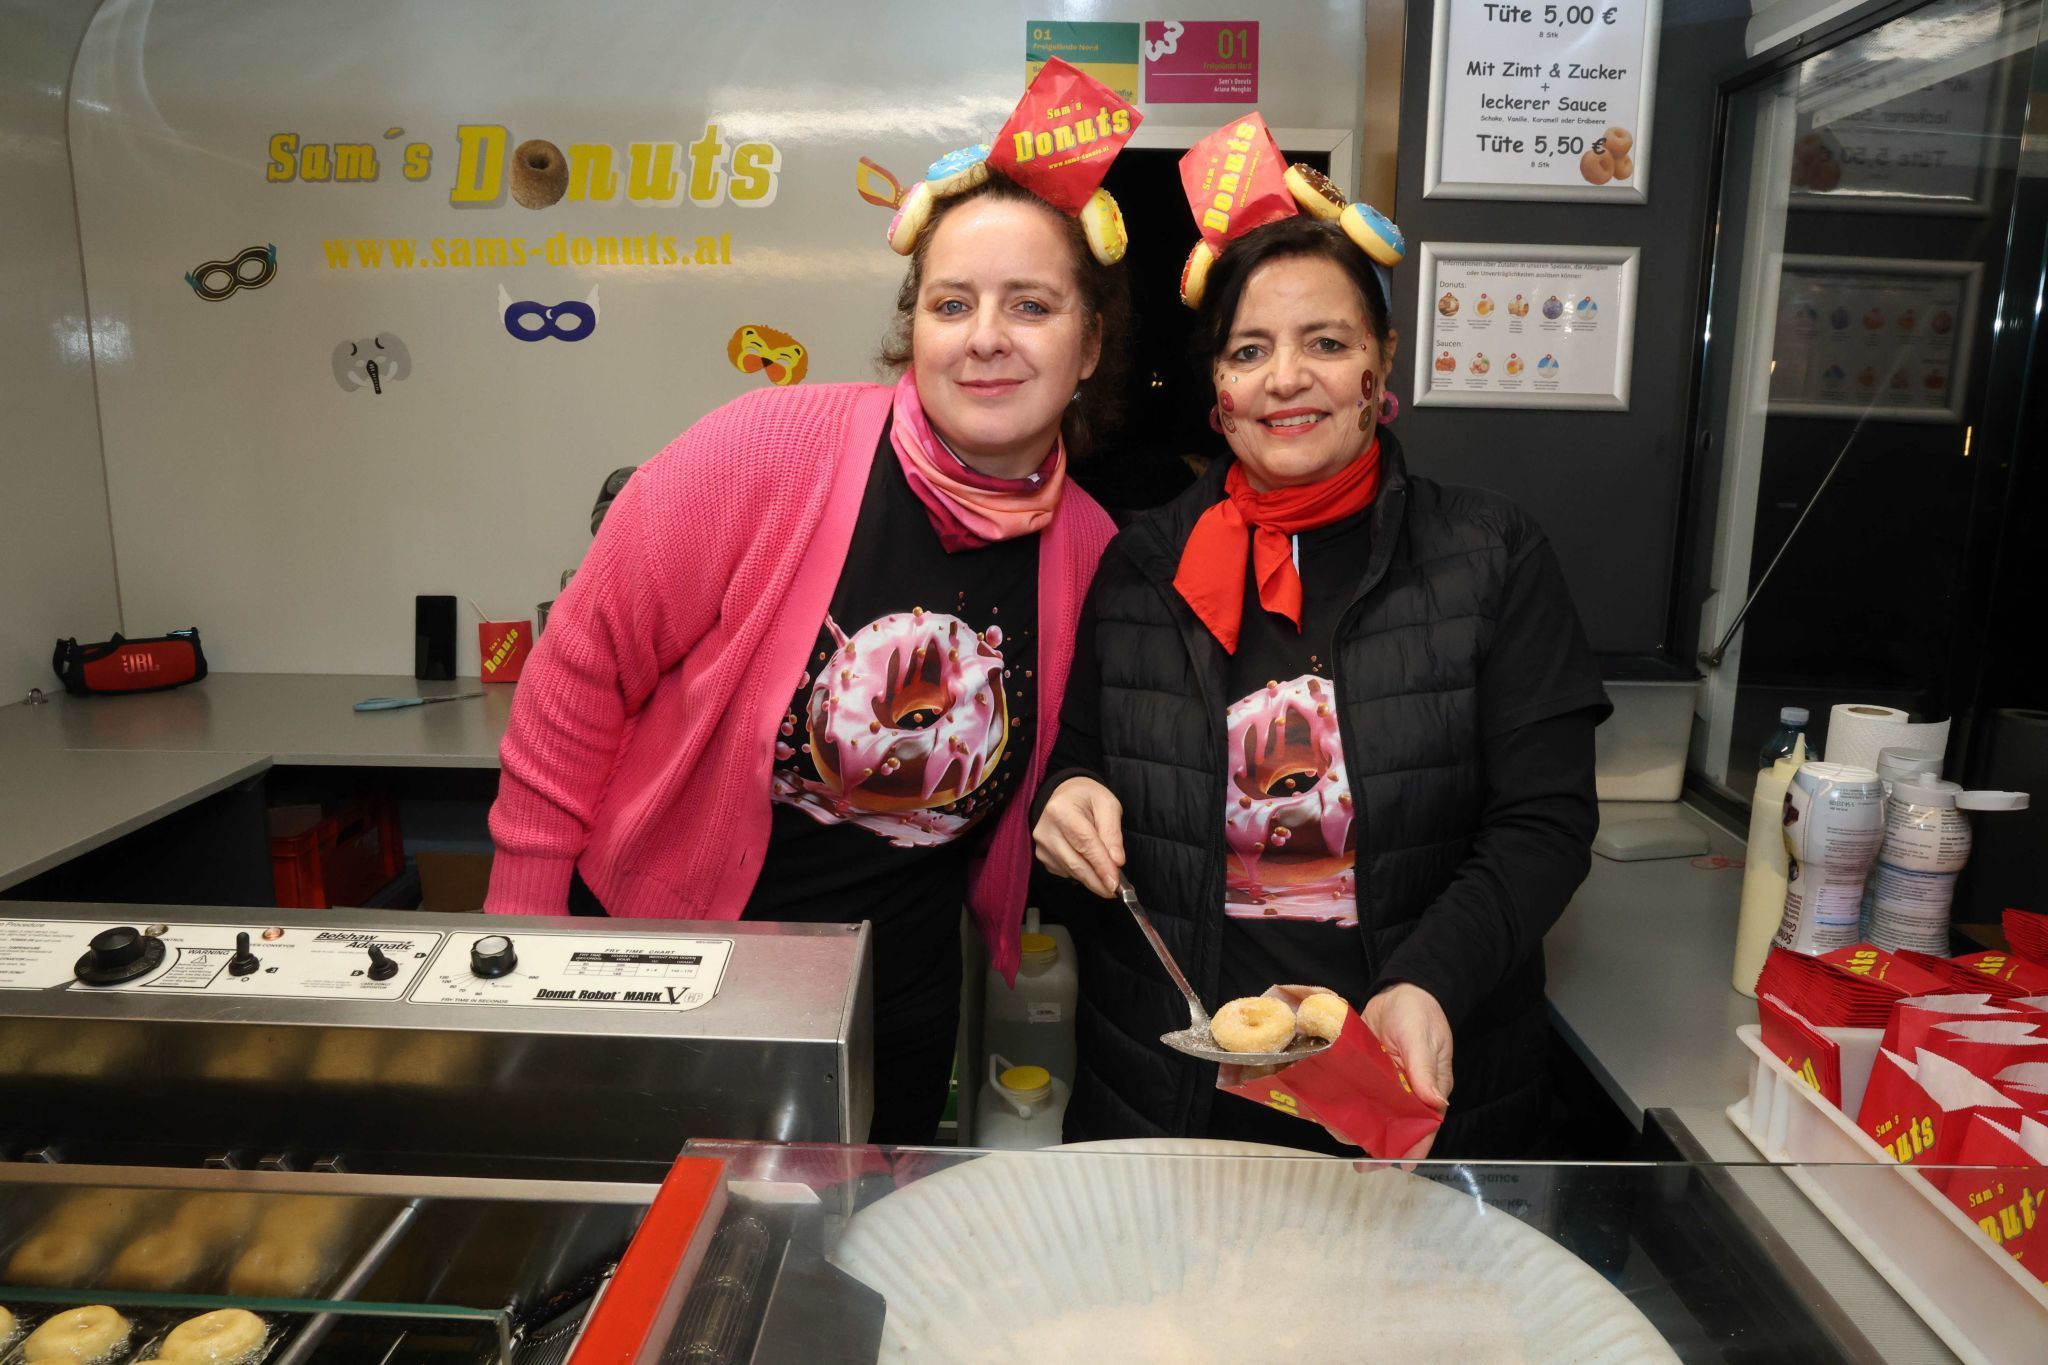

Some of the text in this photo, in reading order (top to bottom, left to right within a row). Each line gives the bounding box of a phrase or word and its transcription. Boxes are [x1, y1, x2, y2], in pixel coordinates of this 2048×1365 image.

[1484, 4, 1617, 27] Tüte 5,00 €
[1033, 29, 1052, 40] 01
[1218, 28, 1248, 59] 01
[1466, 61, 1627, 80] Mit Zimt & Zucker
[1541, 82, 1550, 92] +
[1481, 93, 1607, 112] leckerer Sauce
[1532, 116, 1559, 124] Karamell
[1577, 117, 1606, 125] Erdbeere
[1013, 106, 1131, 163] Donuts
[1476, 134, 1607, 157] Tüte 5,50 €
[1202, 122, 1257, 234] Donuts
[323, 231, 732, 269] www.sams-donuts.at
[1439, 281, 1467, 289] Donuts:
[125, 653, 160, 673] JBL
[315, 932, 379, 941] Belshaw
[346, 941, 415, 951] Adamatic
[536, 988, 577, 999] Donut
[578, 990, 617, 1000] Robot
[623, 991, 663, 1002] MARK
[664, 986, 691, 1005] V
